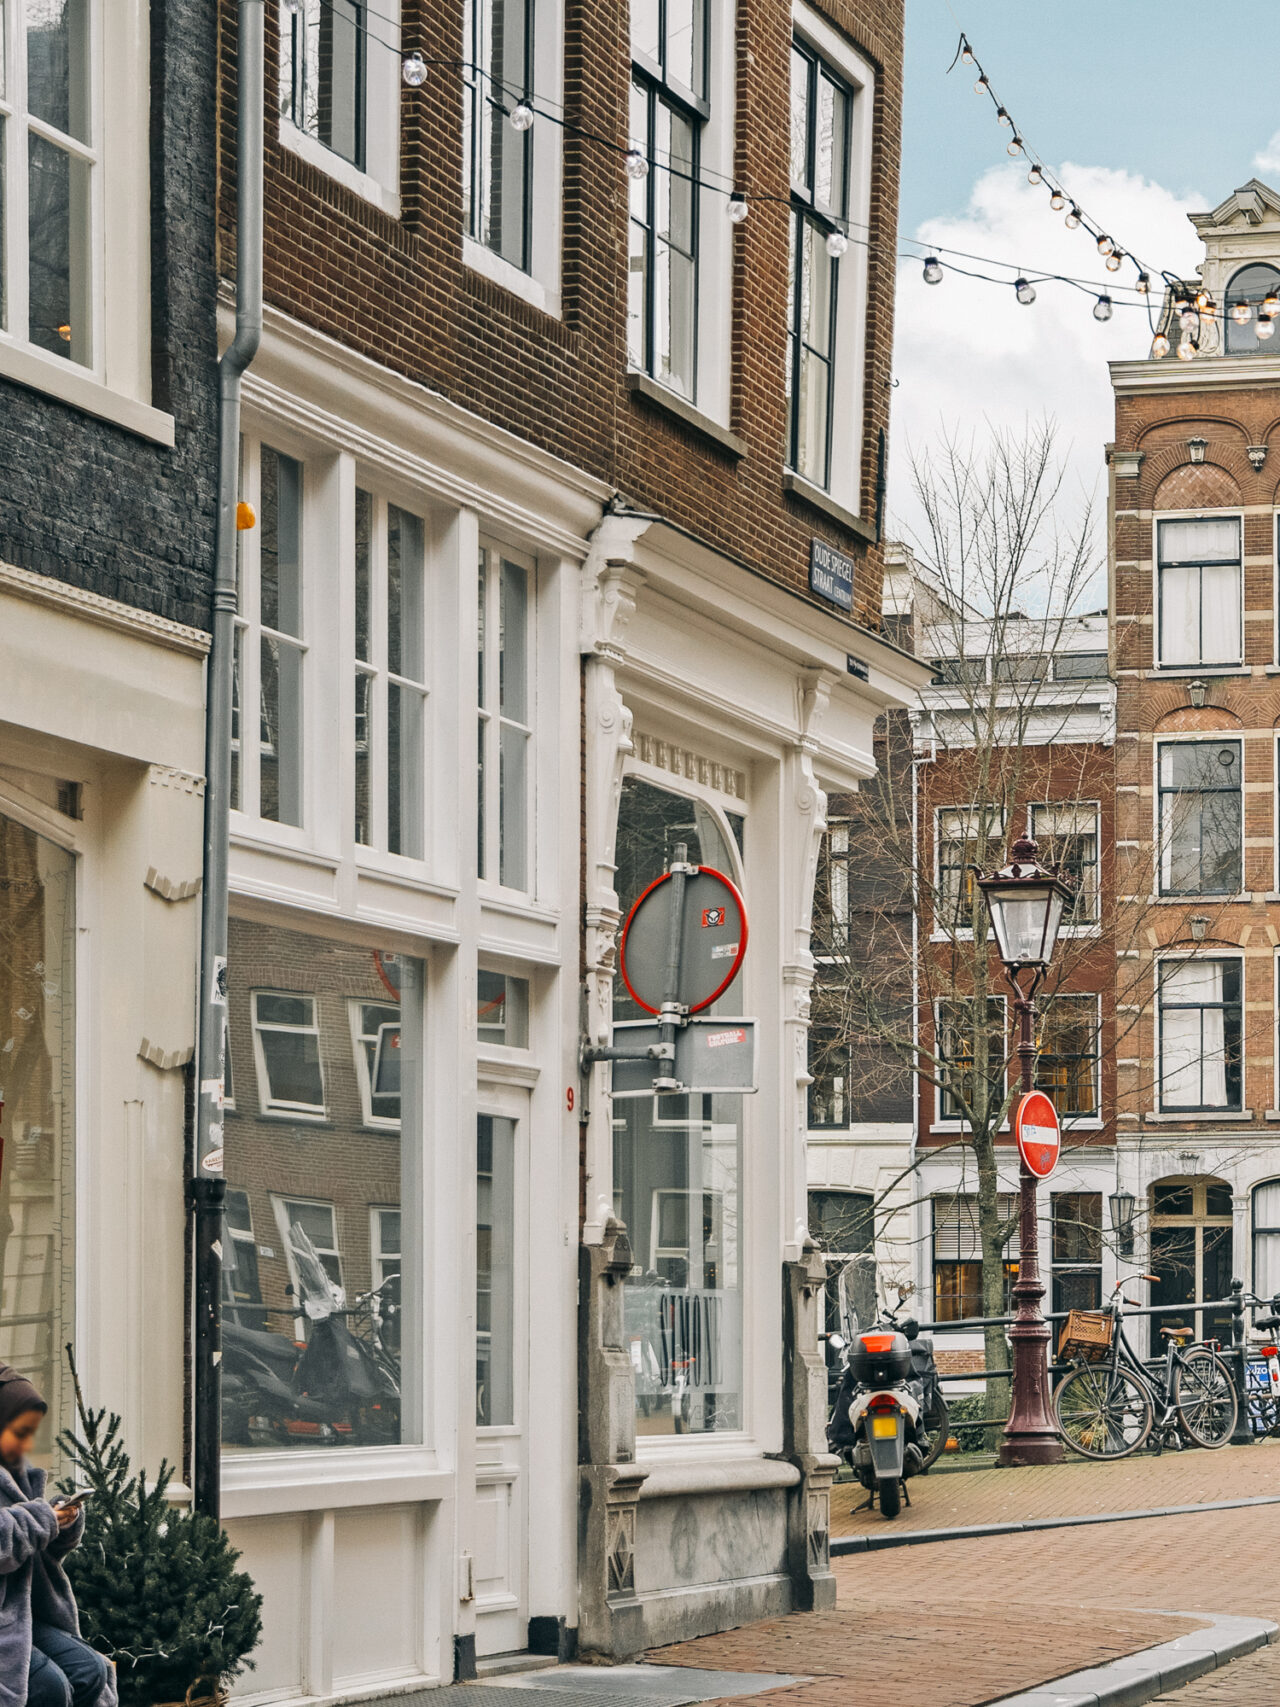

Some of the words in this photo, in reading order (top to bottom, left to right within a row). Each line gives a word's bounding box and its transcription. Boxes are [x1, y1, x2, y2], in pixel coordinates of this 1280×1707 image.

[814, 544, 831, 570] OUDE
[831, 554, 853, 583] SPIEGEL
[813, 567, 834, 594] STRAAT
[566, 1086, 575, 1112] 9
